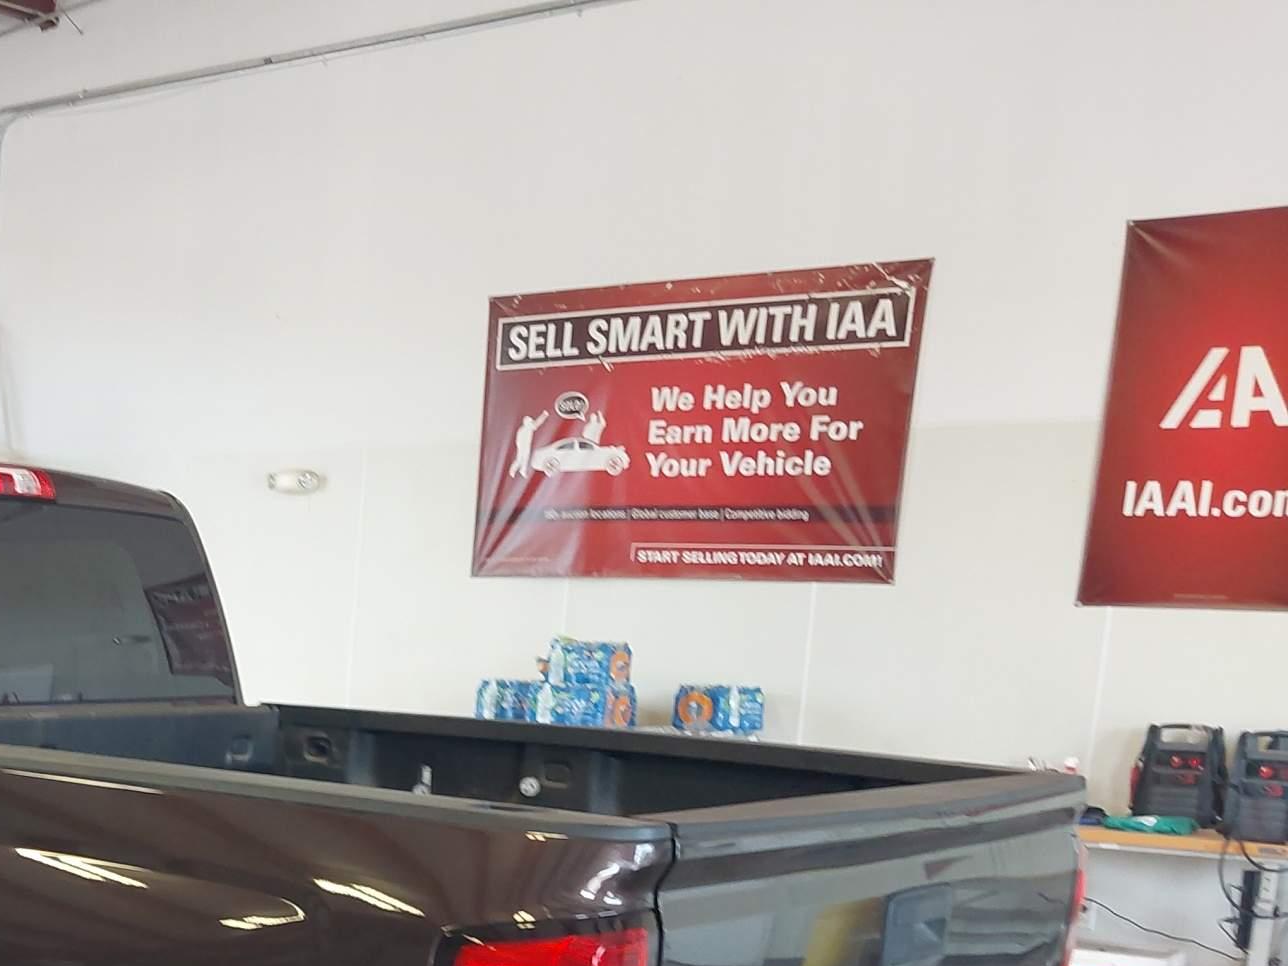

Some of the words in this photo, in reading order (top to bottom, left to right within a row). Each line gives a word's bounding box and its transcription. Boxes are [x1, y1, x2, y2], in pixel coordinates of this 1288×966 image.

[507, 320, 579, 361] SELL
[586, 312, 712, 356] SMART
[718, 303, 816, 346] WITH
[825, 298, 897, 340] IAA
[651, 386, 695, 412] We
[702, 383, 771, 414] Help
[779, 381, 838, 408] You
[648, 419, 712, 445] Earn
[721, 416, 801, 443] More
[809, 415, 863, 441] For
[645, 452, 712, 478] Your
[719, 450, 832, 477] Vehicle
[636, 549, 680, 564] START
[681, 551, 738, 565] SELLING
[739, 551, 786, 566] TODAY
[787, 552, 807, 566] AT
